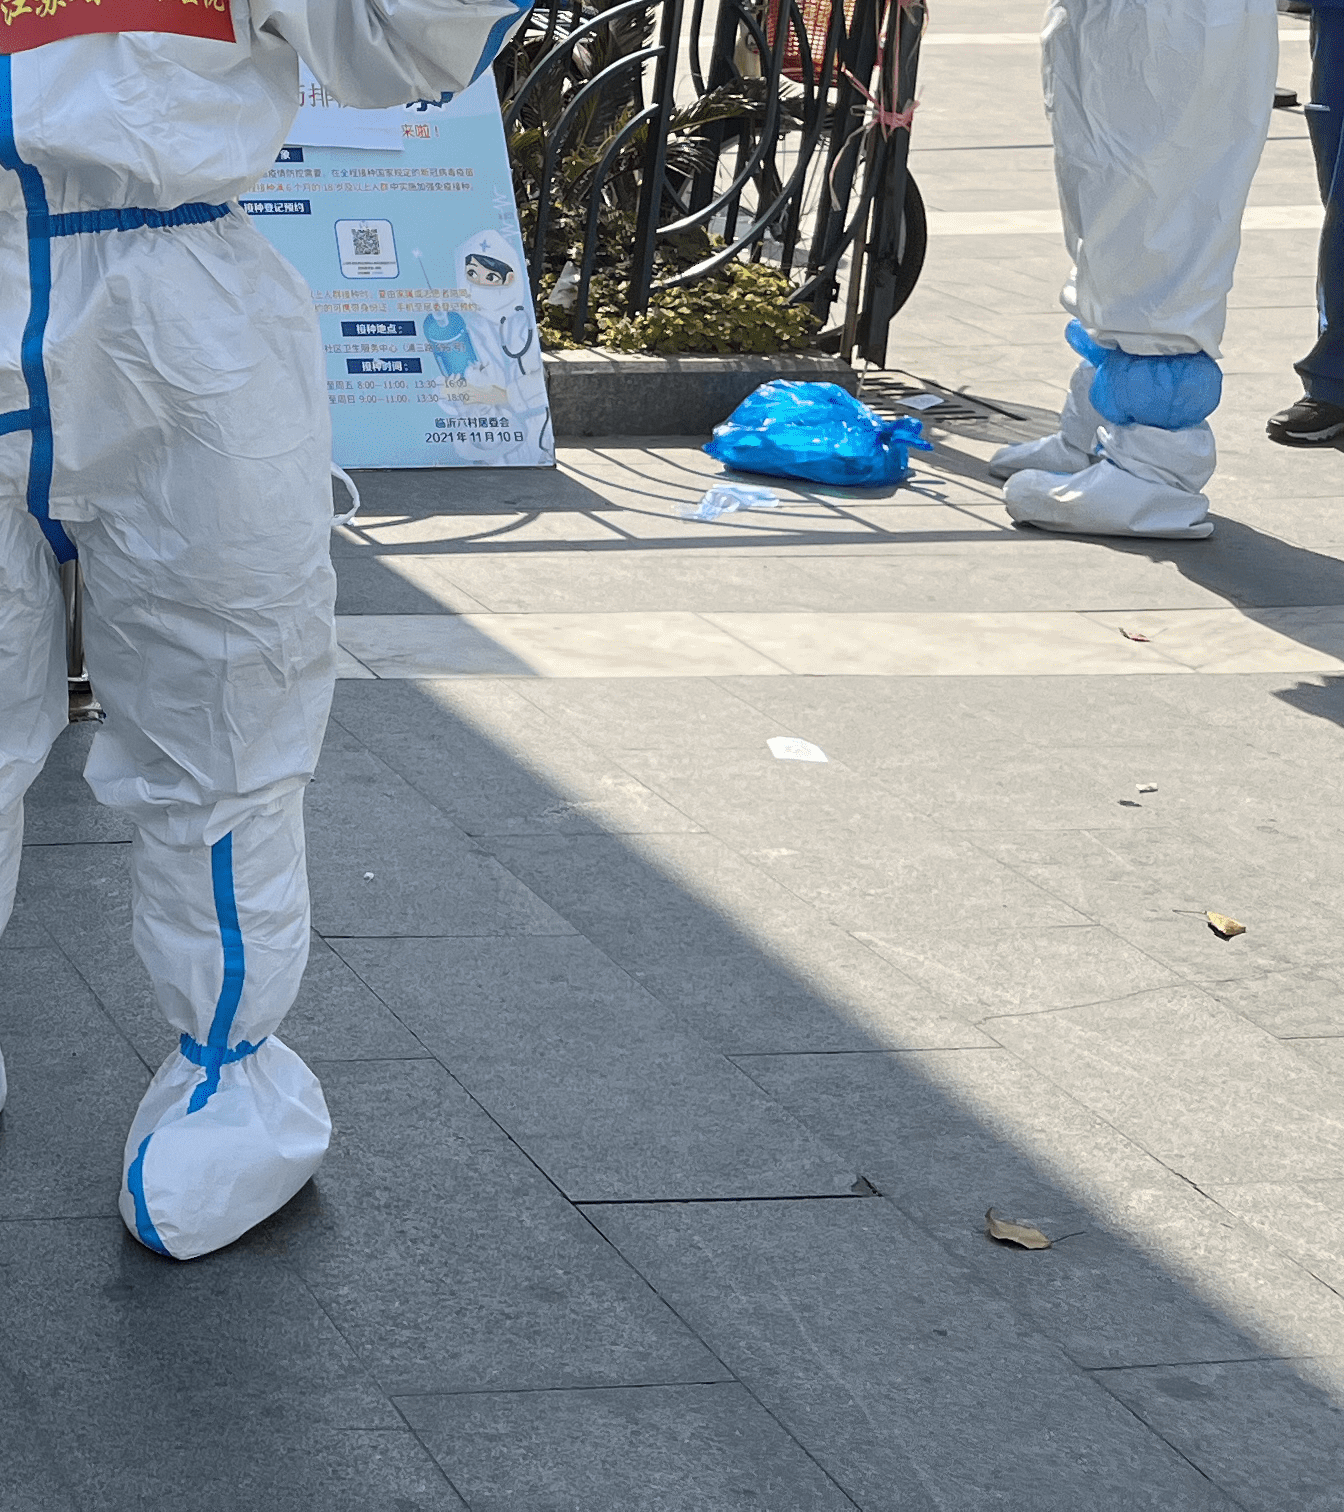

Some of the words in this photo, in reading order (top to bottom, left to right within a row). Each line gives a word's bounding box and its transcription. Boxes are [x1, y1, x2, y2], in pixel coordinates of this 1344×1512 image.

[434, 416, 510, 429] 临沂六村居委会
